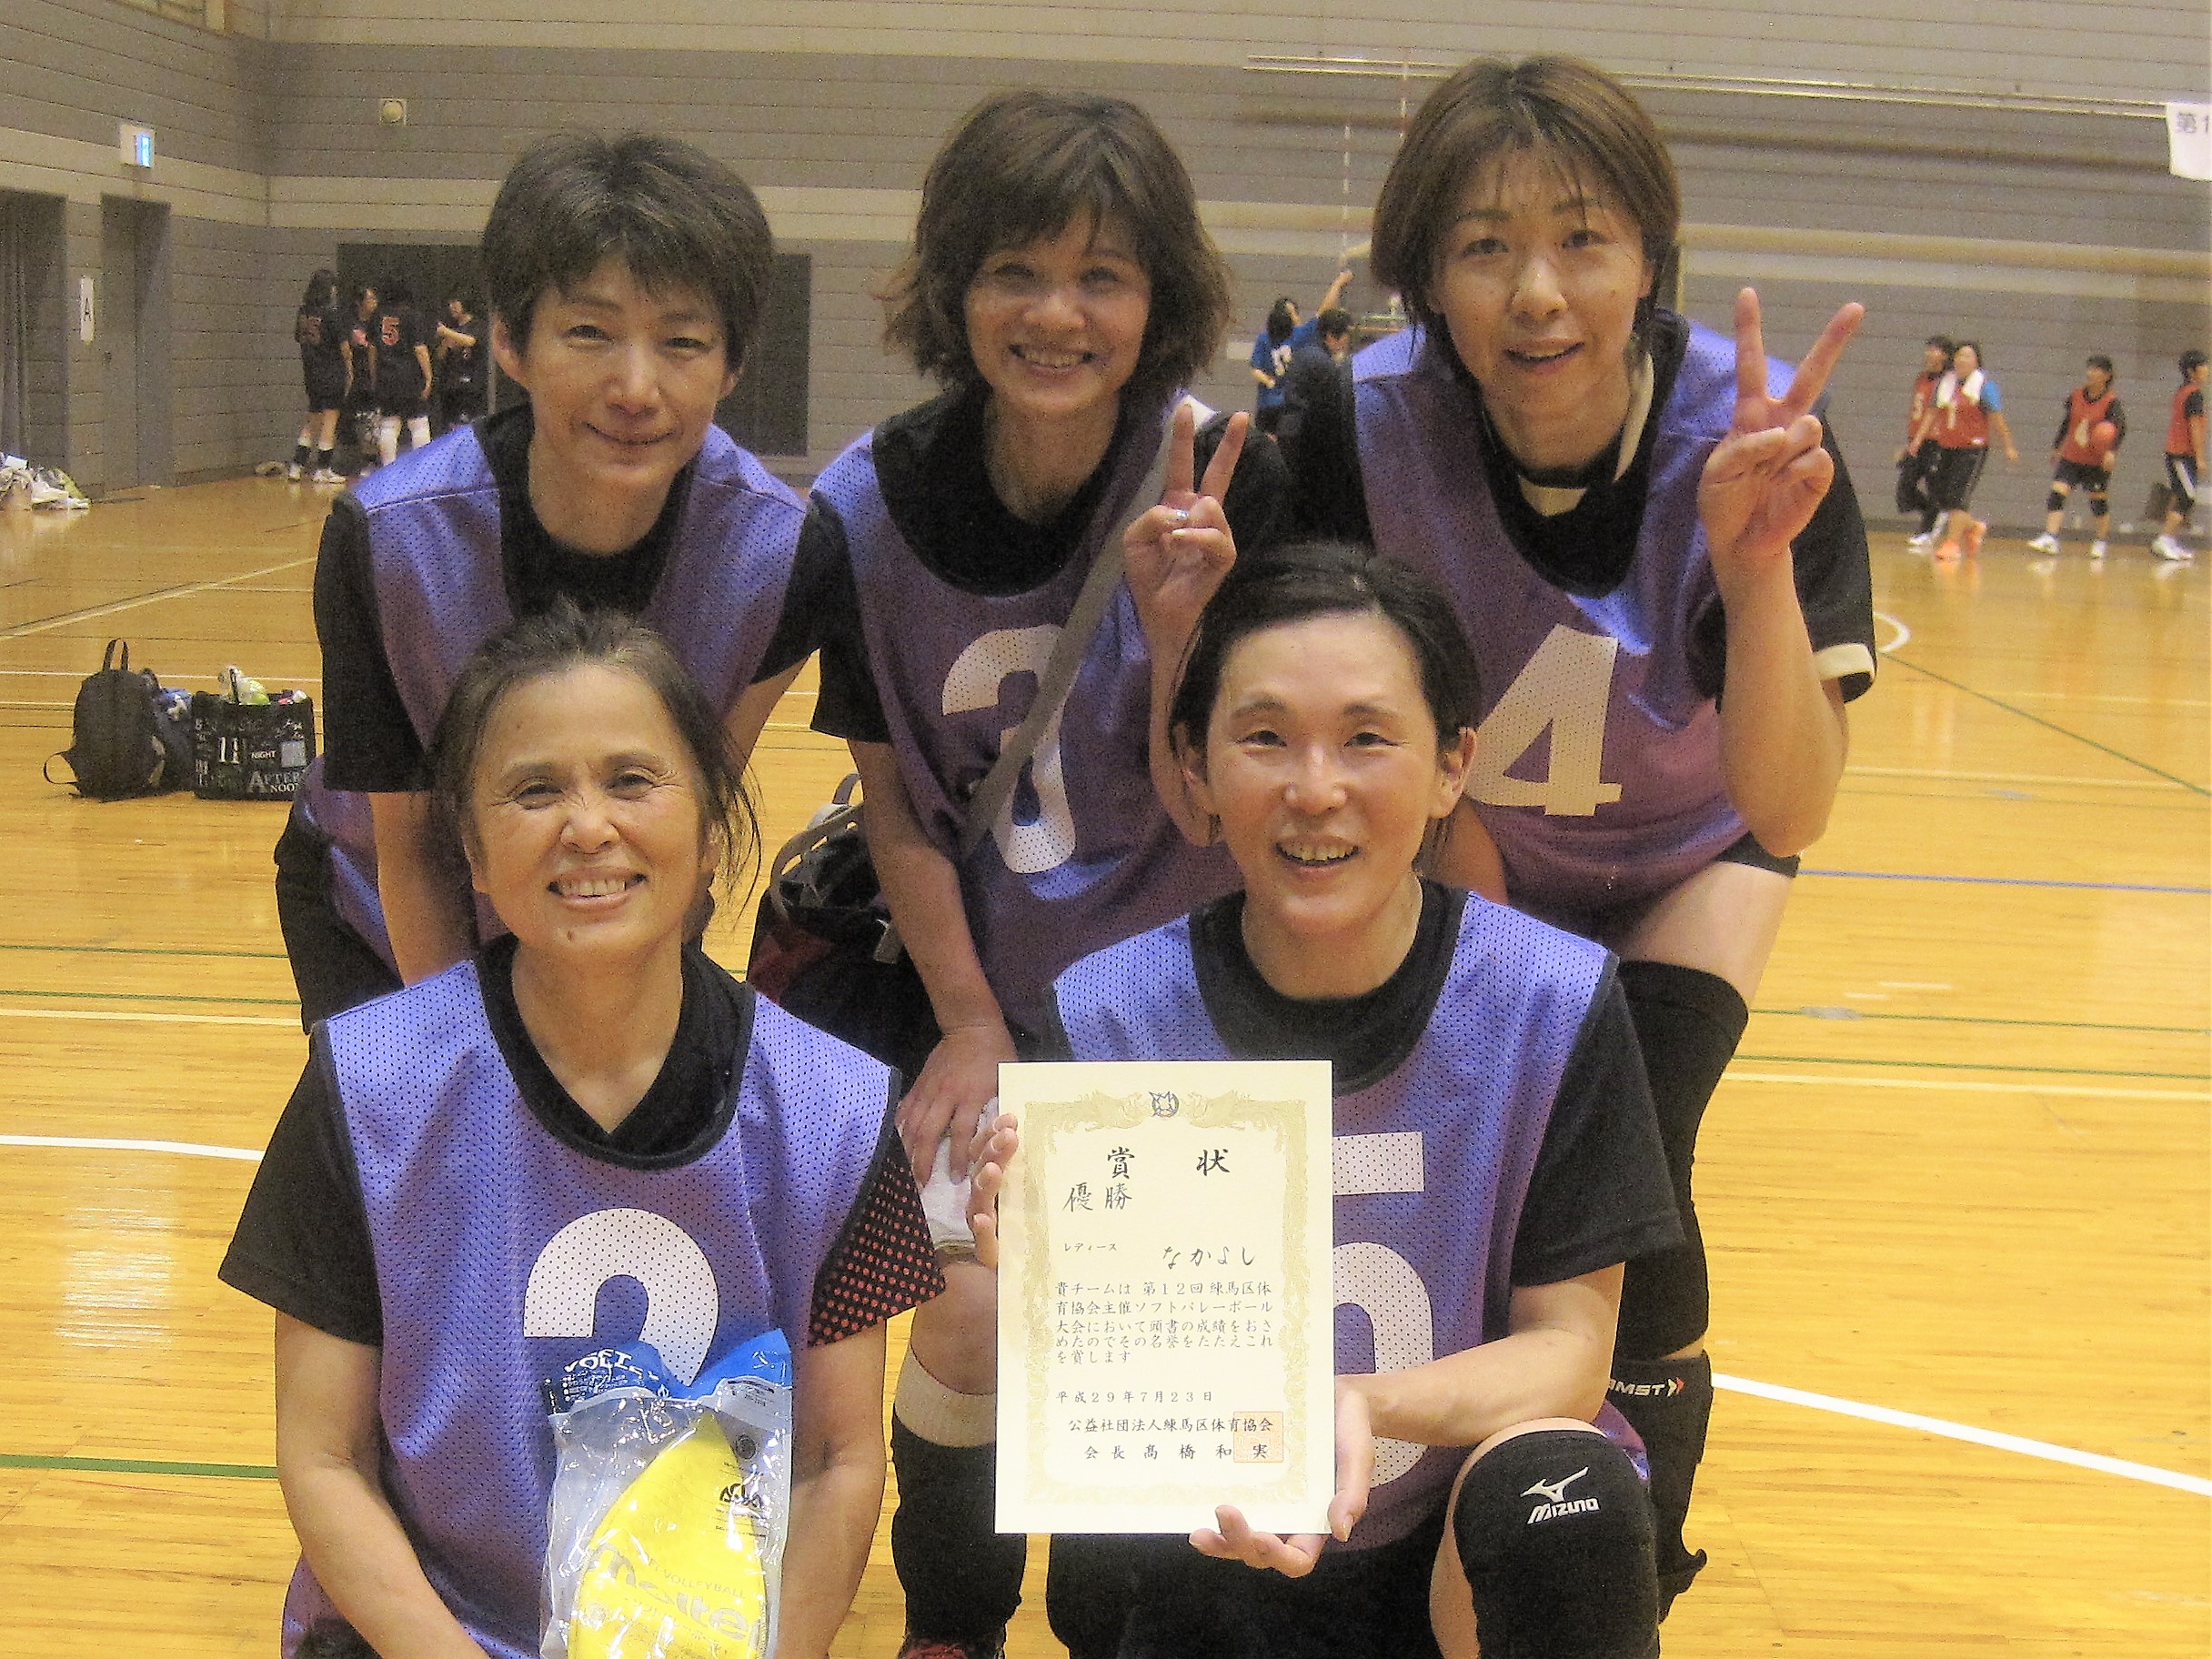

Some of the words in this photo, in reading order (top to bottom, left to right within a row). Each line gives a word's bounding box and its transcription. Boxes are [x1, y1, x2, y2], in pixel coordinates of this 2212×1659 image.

[84, 297, 92, 321] A
[382, 317, 400, 346] 5
[1464, 624, 1622, 817] 4
[250, 749, 276, 759] NIGHT
[942, 623, 1076, 874] 3
[1062, 1181, 1132, 1212] 優勝
[1162, 1245, 1255, 1270] なかよし
[1056, 1351, 1131, 1364] を賞します
[1068, 1417, 1274, 1433] 公益社団法人練馬区体育協会
